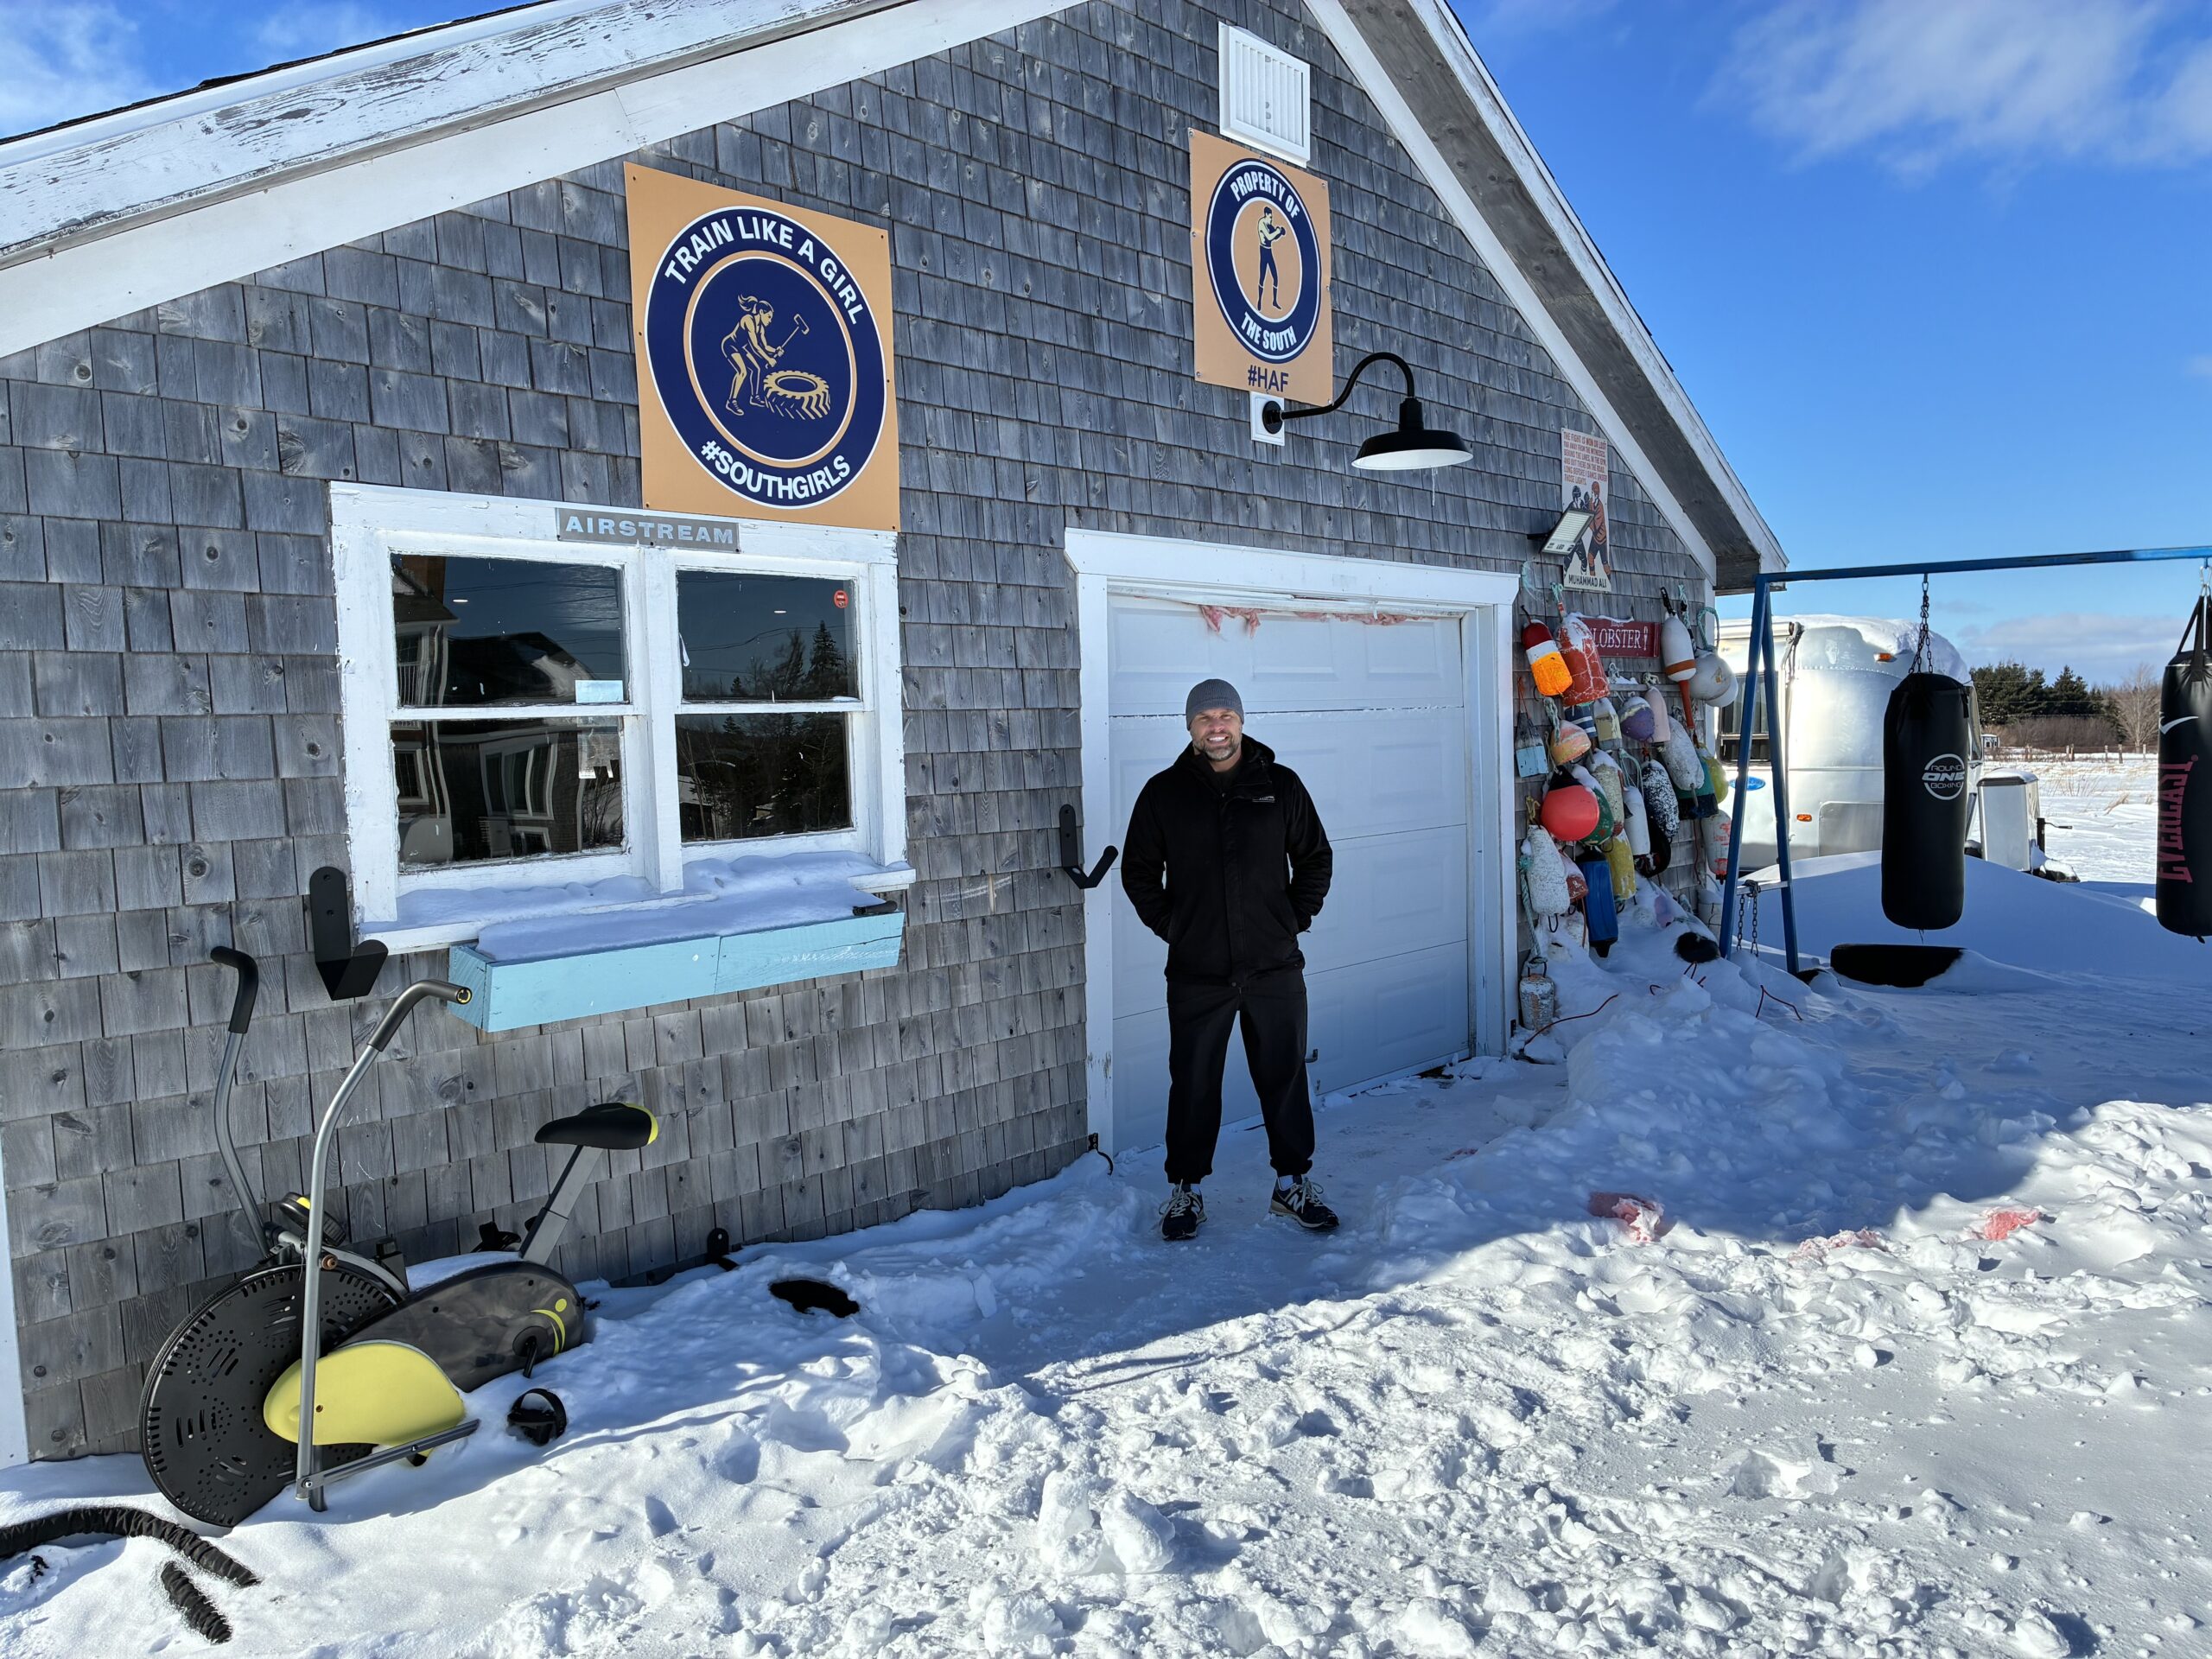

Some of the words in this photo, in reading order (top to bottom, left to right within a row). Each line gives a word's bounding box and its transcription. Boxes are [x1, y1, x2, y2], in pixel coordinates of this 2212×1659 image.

[1230, 170, 1286, 202] PROPERTY
[1285, 196, 1300, 219] OF
[664, 217, 734, 285] TRAIN
[738, 216, 793, 249] LIKE
[798, 238, 815, 264] A
[820, 257, 865, 326] GIRL
[1241, 312, 1262, 345] THE
[1262, 325, 1297, 352] SOUTH
[1248, 365, 1289, 392] #HAF
[1572, 434, 1581, 443] FIGHT
[701, 439, 851, 499] #SOUTHGIRLS
[565, 516, 733, 544] AIRSTREAM
[1568, 574, 1598, 587] MUHAMMAD
[1592, 627, 1642, 649] LOBSTER
[1922, 771, 1965, 781] ONE
